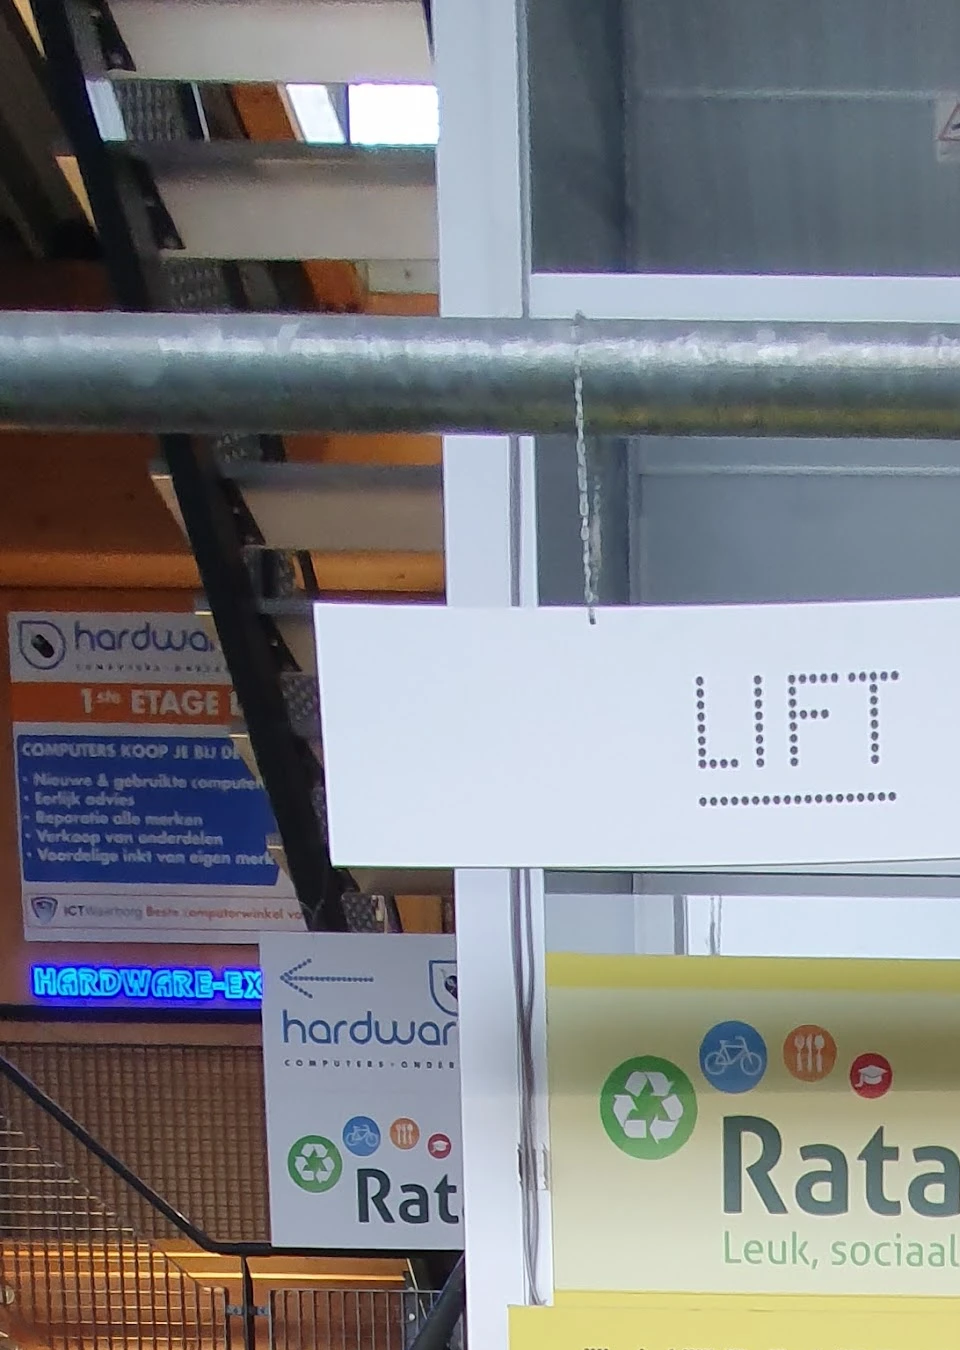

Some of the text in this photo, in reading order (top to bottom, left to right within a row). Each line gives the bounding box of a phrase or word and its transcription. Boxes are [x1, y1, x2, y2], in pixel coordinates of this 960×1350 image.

[74, 620, 214, 652] hardwa
[131, 689, 219, 715] ETAGE
[696, 669, 900, 770] LIFT
[22, 742, 117, 758] COMPUTERS
[120, 743, 169, 759] KOOP
[173, 745, 189, 759] JE
[194, 745, 217, 759] BIJ
[33, 772, 93, 787] Nieuwe
[113, 773, 187, 791] gebruikte
[35, 791, 135, 809] Eerlijk advies
[35, 810, 204, 828] Reparatie alle merken
[35, 829, 224, 846] Verkoop van onderdelen
[37, 847, 119, 866] Voordelige
[122, 848, 152, 863] inkt
[156, 853, 186, 864] van
[189, 850, 231, 868] eigen
[184, 907, 283, 923] computerwinkel
[282, 1009, 456, 1046] hardwar
[284, 1059, 384, 1068] COMPUTERS
[723, 1230, 819, 1270] Leuk,
[830, 1233, 960, 1269] sociaal
